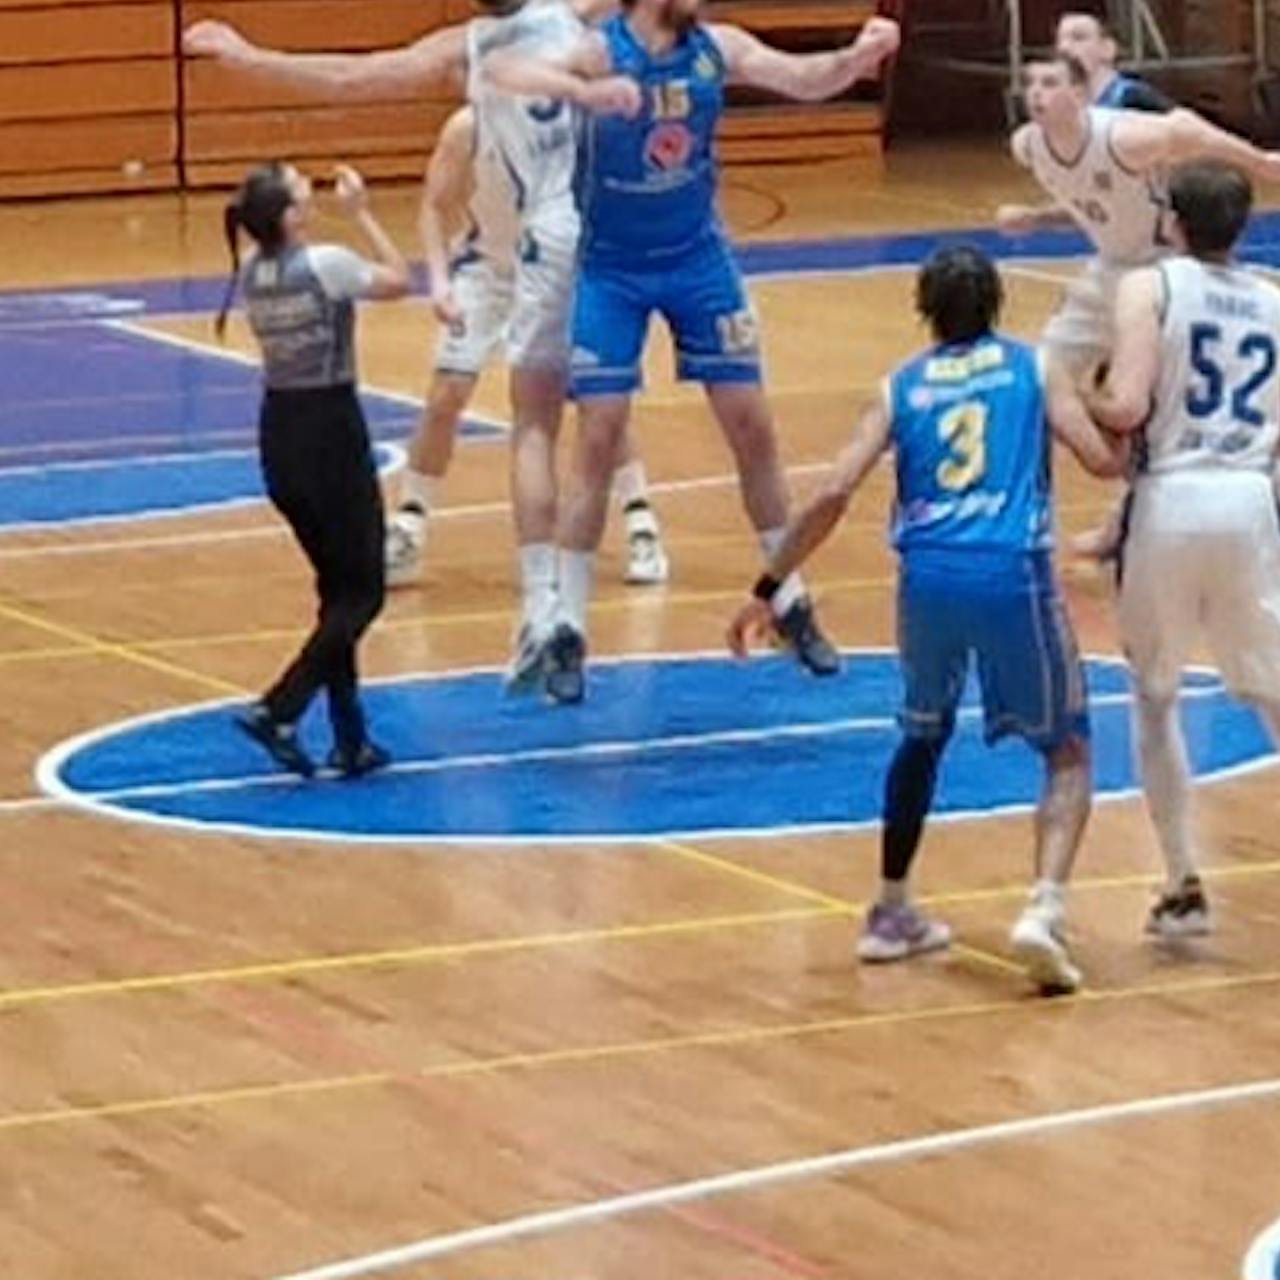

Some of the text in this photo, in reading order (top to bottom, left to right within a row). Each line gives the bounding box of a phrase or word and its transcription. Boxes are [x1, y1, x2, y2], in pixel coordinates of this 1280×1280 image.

[651, 79, 691, 120] 15
[1184, 322, 1277, 426] 52
[936, 401, 988, 492] 3
